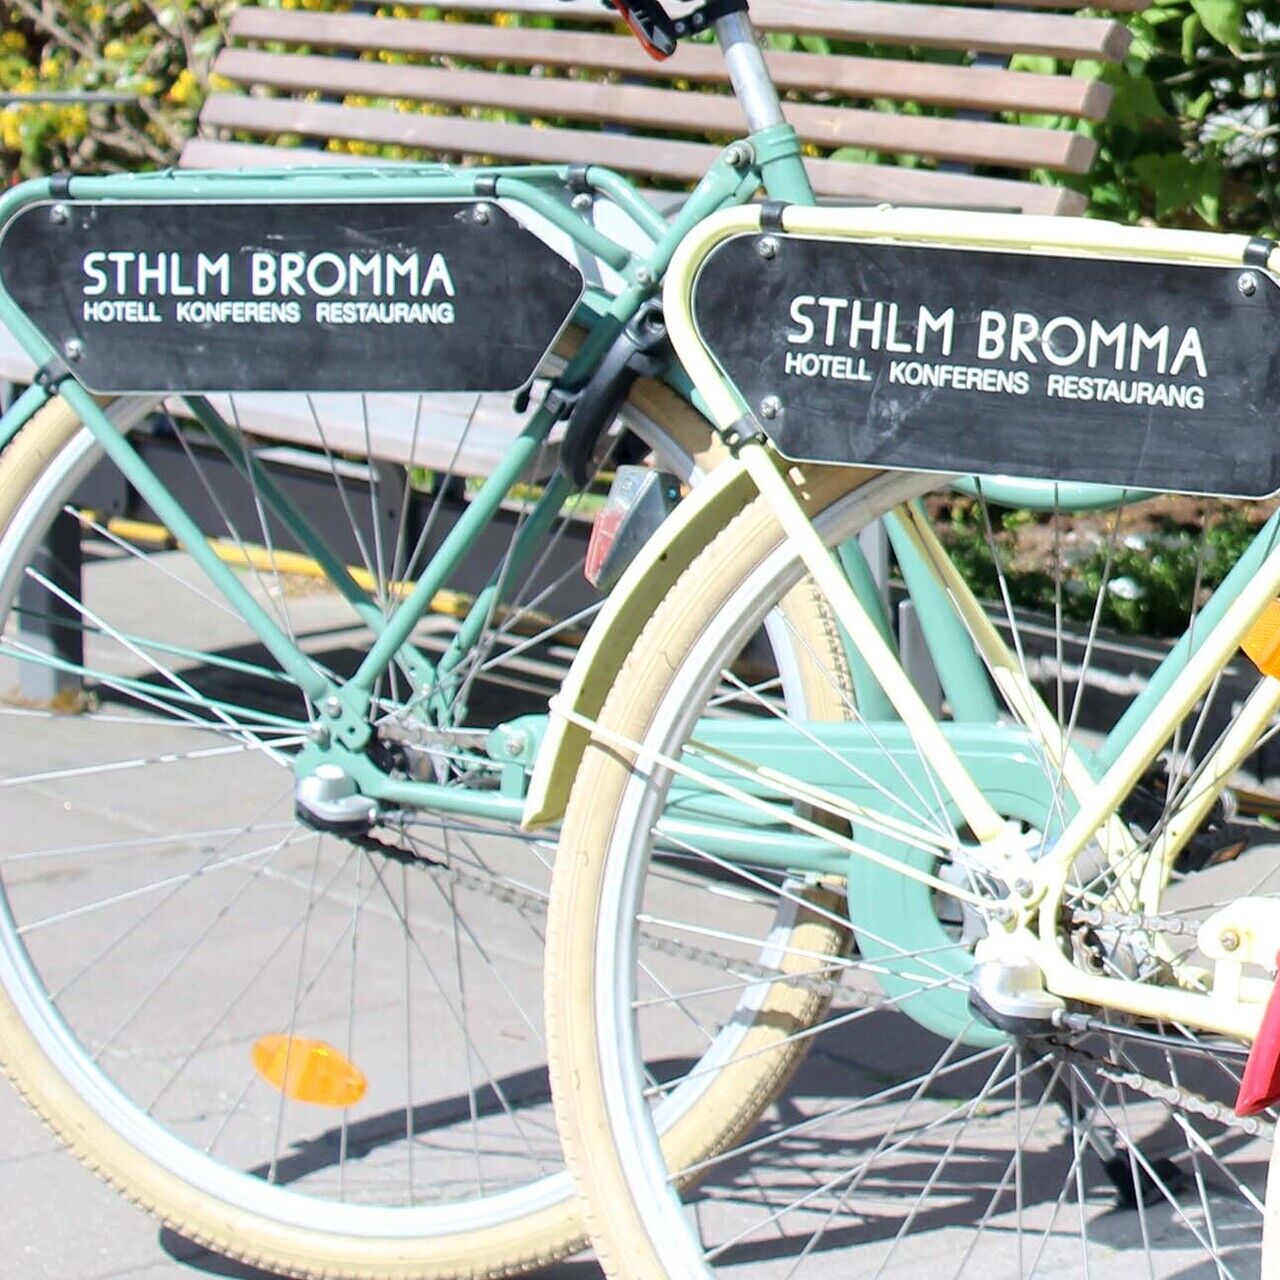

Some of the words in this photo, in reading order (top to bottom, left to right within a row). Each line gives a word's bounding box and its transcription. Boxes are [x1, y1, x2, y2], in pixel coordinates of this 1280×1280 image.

[82, 251, 230, 296] STHLM
[251, 252, 455, 297] BROMMA
[83, 300, 163, 323] HOTELL
[176, 300, 302, 324] KONFERENS
[315, 301, 455, 325] RESTAURANG
[788, 296, 955, 356] STHLM
[977, 310, 1208, 378] BROMMA
[784, 351, 873, 382] HOTELL
[888, 360, 1030, 395] KONFERENS
[1046, 373, 1205, 410] RESTAURANG
